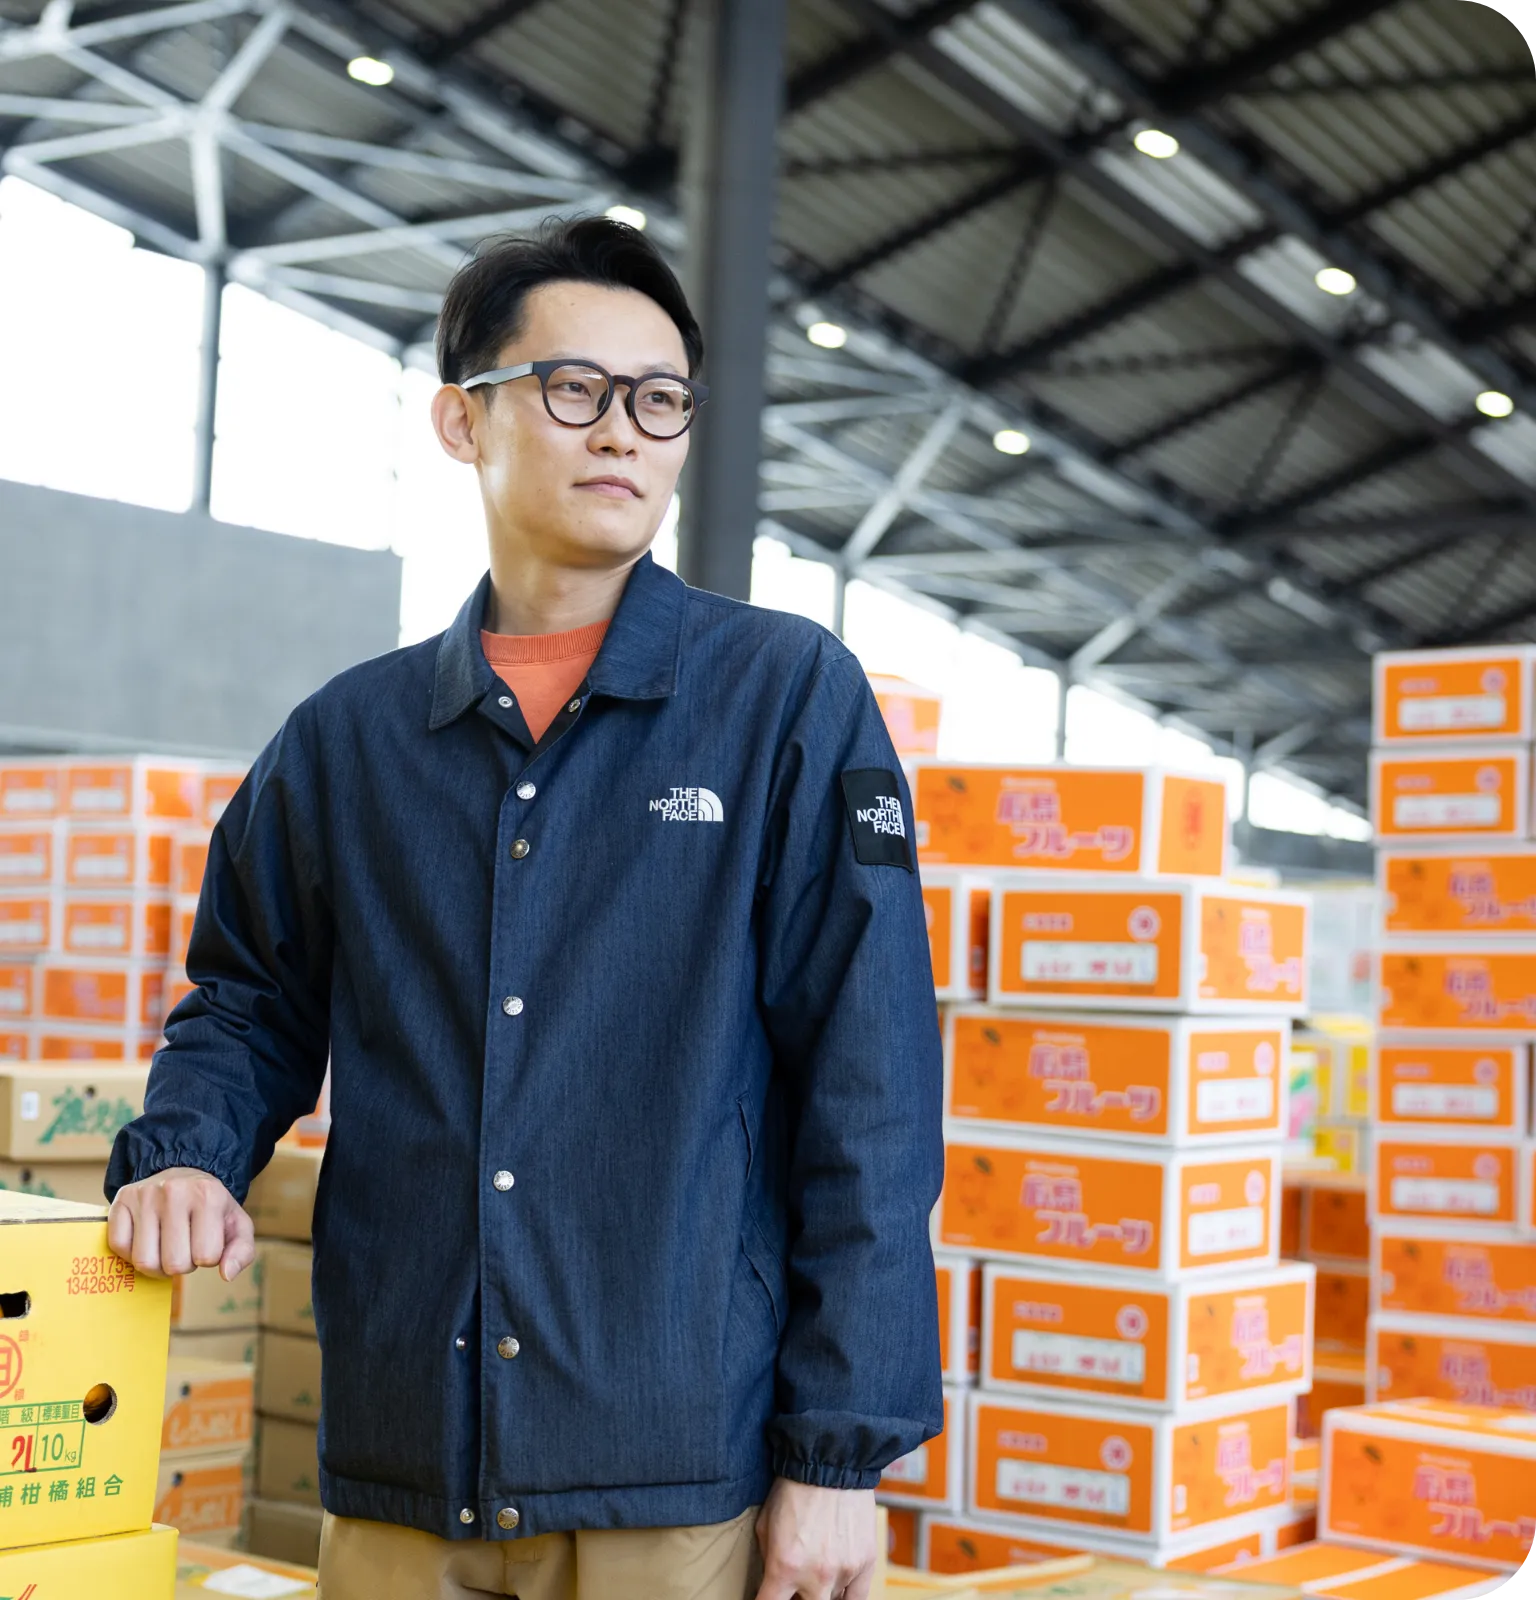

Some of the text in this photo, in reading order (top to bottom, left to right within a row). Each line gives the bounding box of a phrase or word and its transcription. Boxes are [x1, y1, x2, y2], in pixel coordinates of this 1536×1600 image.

[669, 787, 698, 799] THE
[649, 798, 698, 811] NORTH
[875, 795, 898, 810] THE
[662, 809, 698, 821] FACE
[856, 808, 899, 823] NORTH
[873, 820, 901, 836] FACE
[1042, 1078, 1162, 1122] フルーツ
[1034, 1209, 1154, 1255] フルーツ
[66, 1273, 136, 1296] 1342637号
[11, 1432, 77, 1473] 2L 10 kg
